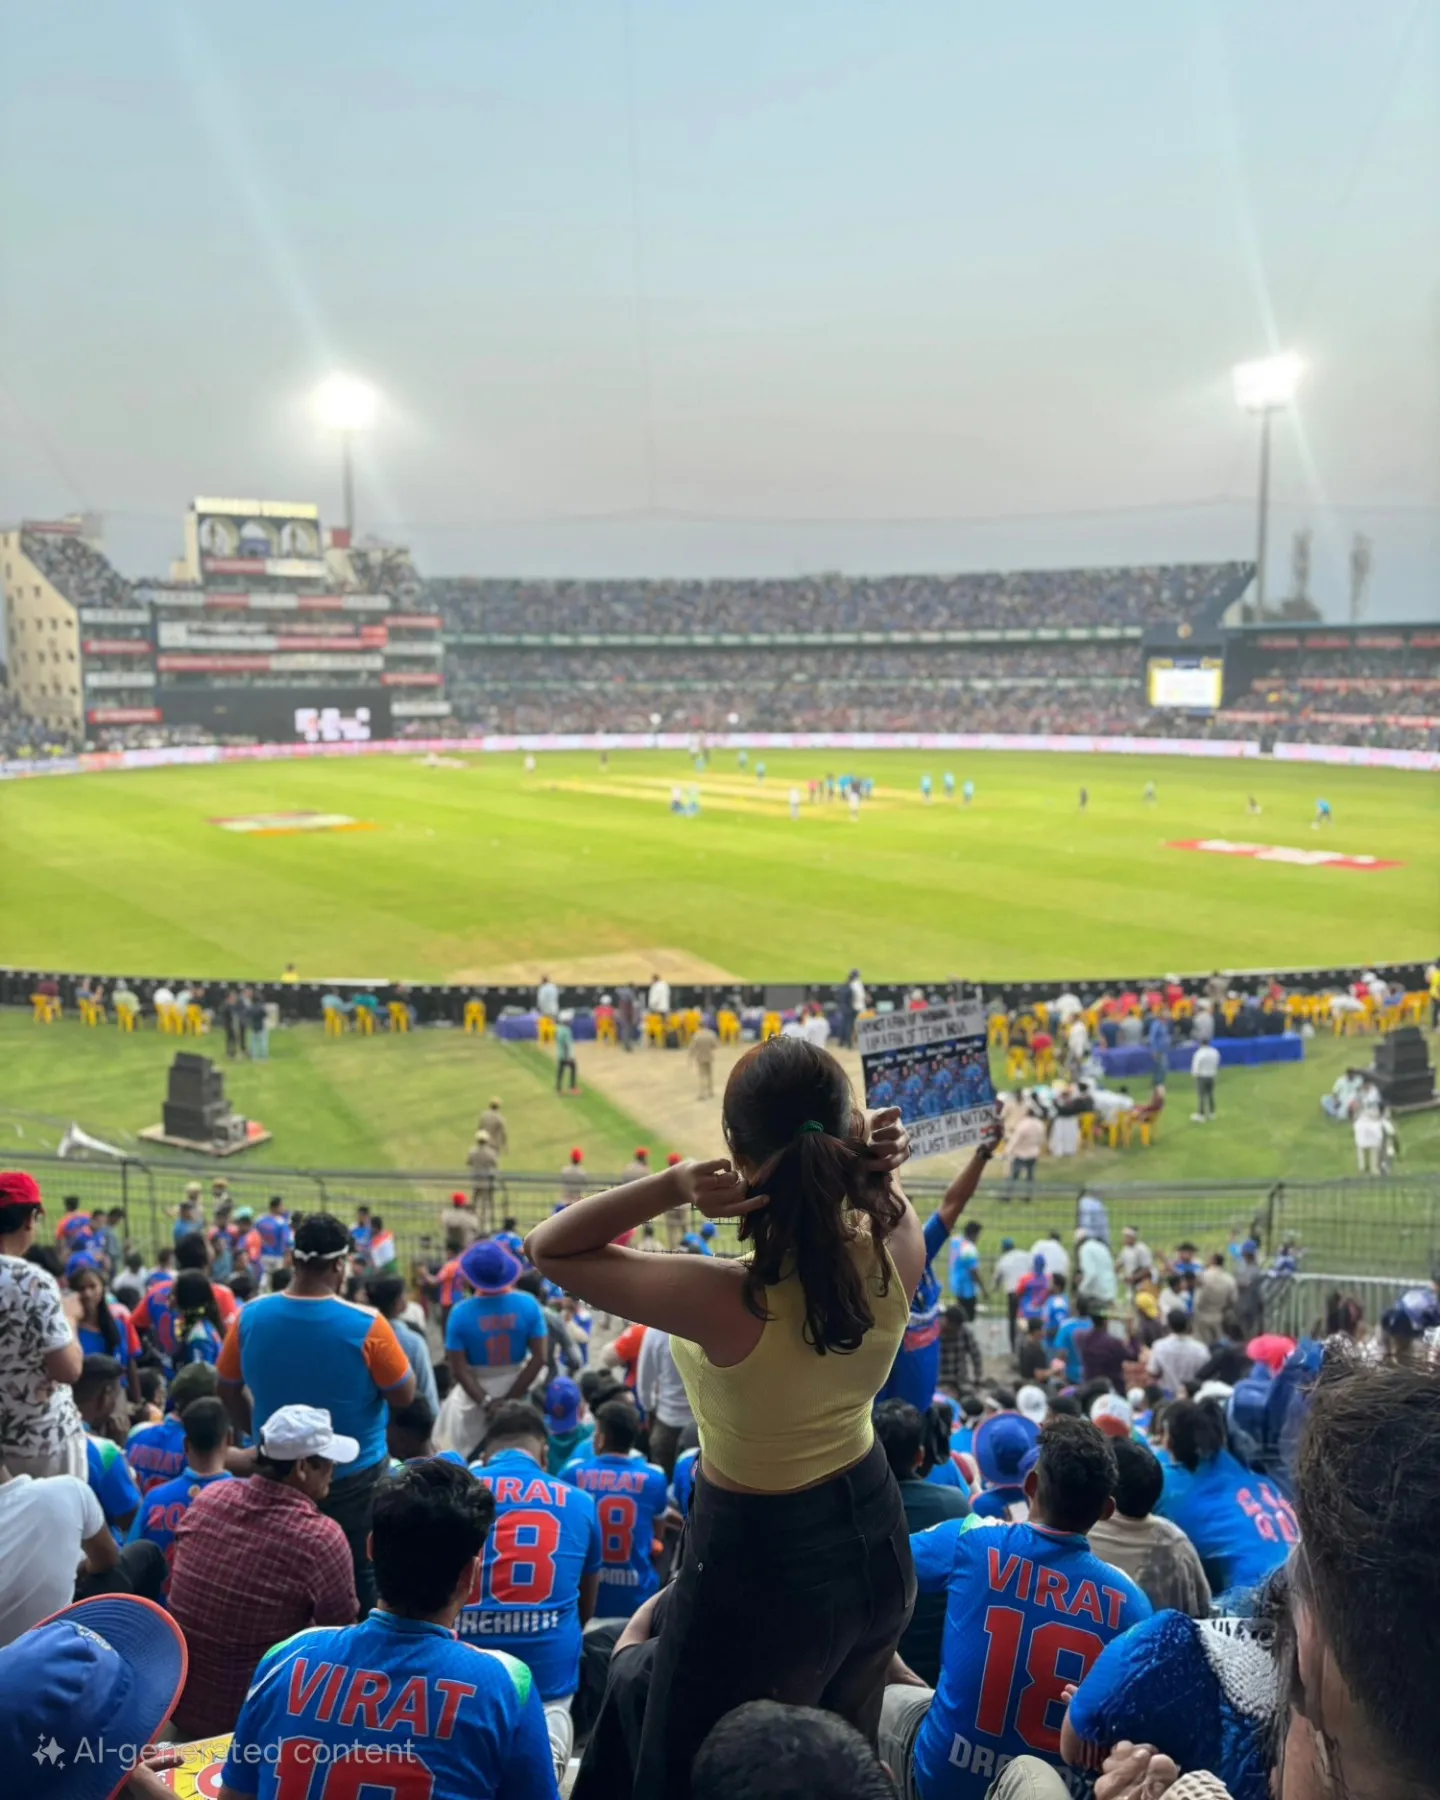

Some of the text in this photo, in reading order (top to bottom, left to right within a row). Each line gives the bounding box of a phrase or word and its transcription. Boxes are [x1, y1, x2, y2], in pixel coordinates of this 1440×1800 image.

[575, 1468, 649, 1494] VIRAT
[988, 1546, 1127, 1630] VIRAT
[287, 1657, 477, 1740] VIRAT
